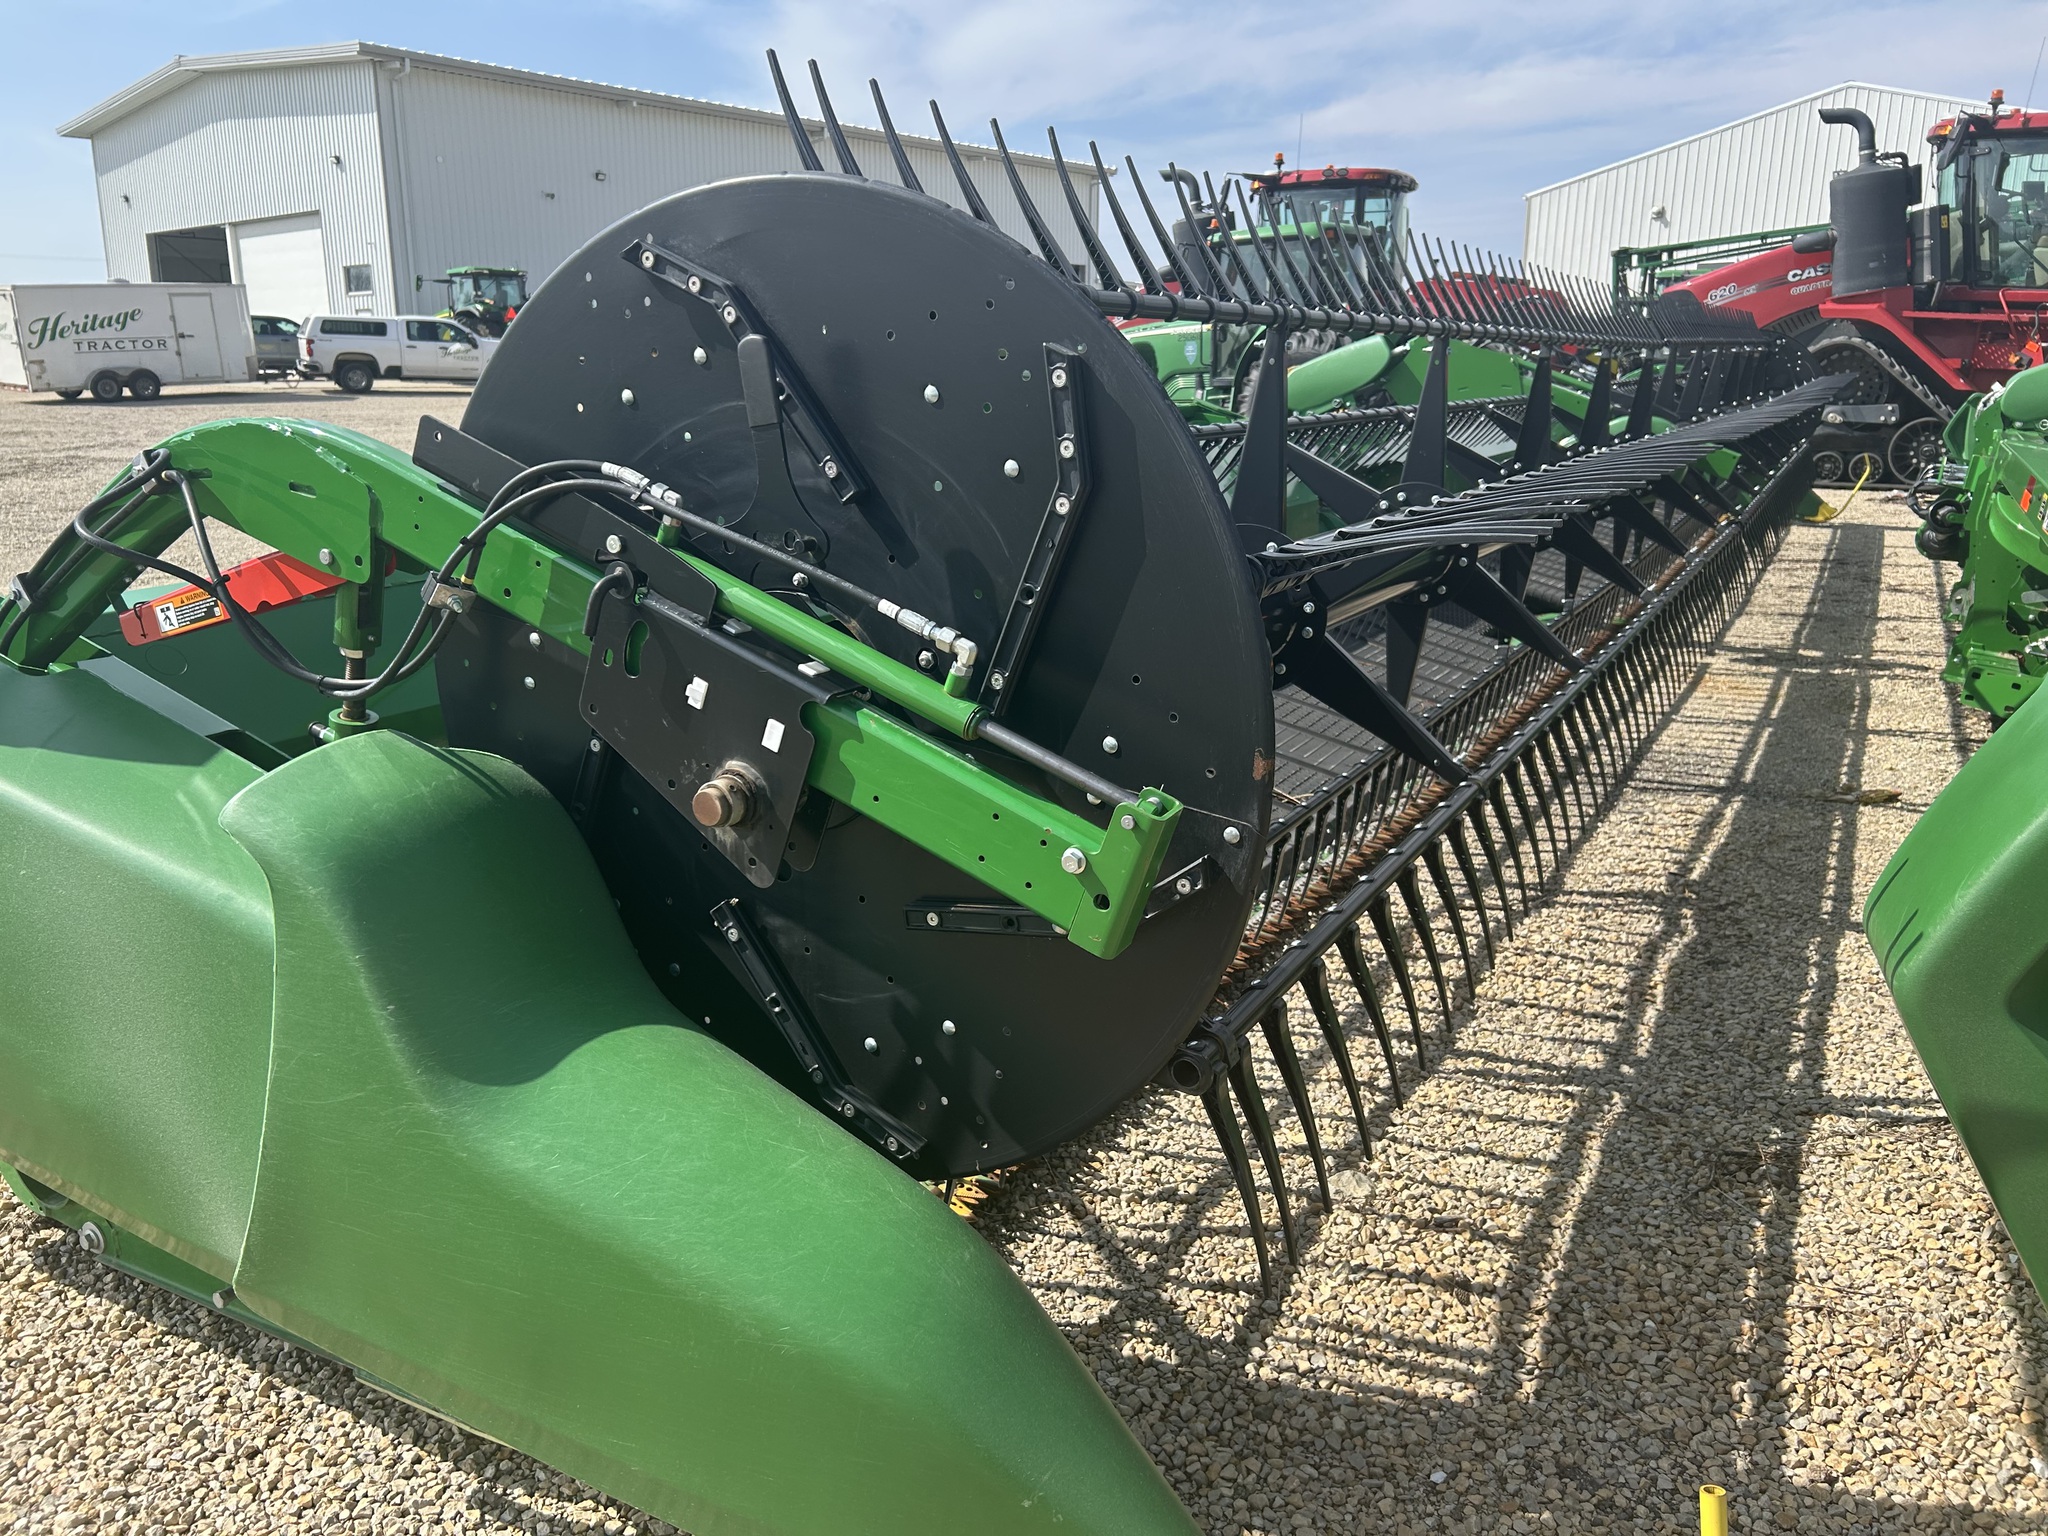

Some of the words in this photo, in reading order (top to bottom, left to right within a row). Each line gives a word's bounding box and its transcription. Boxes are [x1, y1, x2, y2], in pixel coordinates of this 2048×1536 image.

[1787, 262, 1831, 282] CAS
[1708, 283, 1738, 302] 620
[1790, 279, 1832, 296] QUADTR
[27, 307, 143, 350] Heritage
[73, 339, 168, 351] TRACTOR
